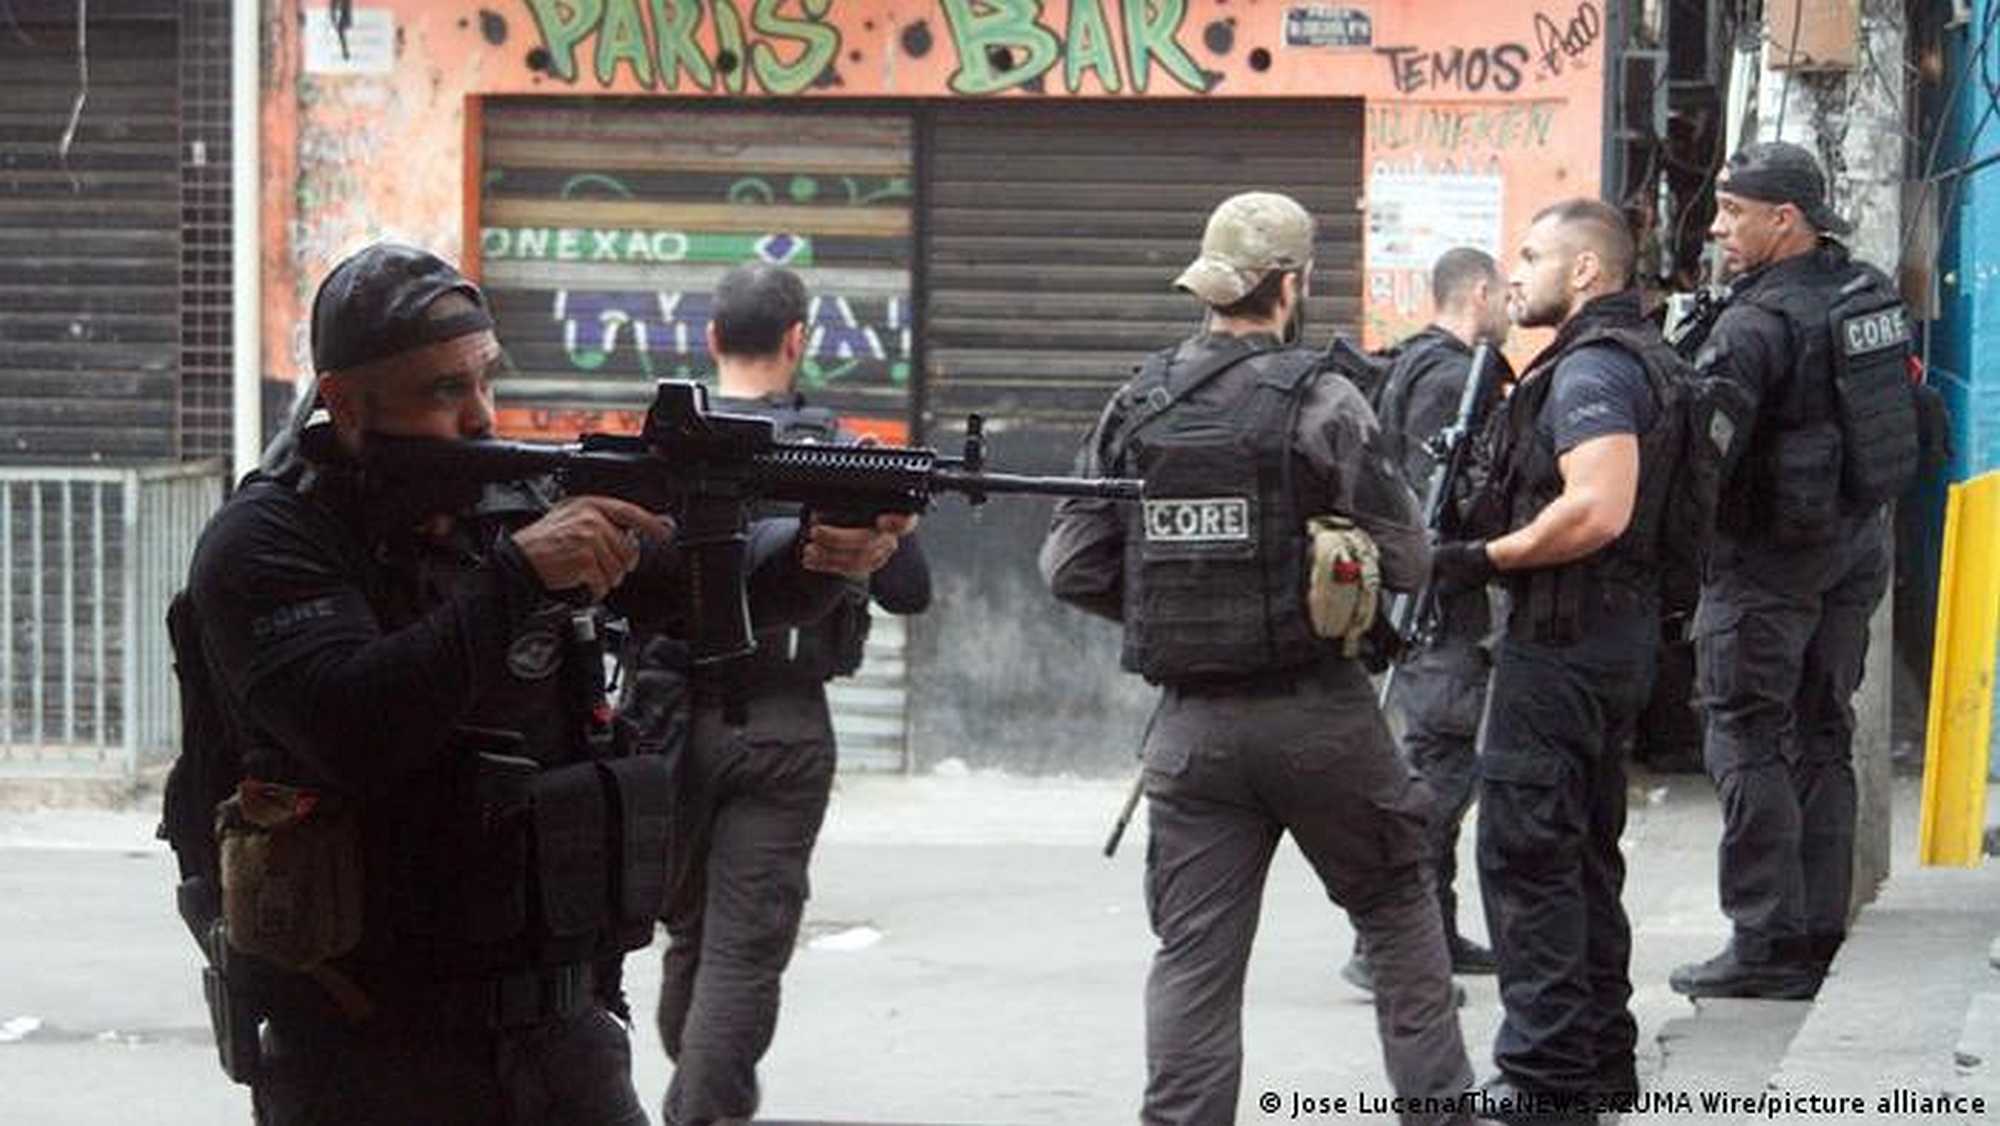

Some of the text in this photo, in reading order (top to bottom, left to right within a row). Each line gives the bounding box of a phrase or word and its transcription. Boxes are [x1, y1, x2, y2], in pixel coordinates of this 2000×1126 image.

[524, 0, 1209, 96] PARIS BAR
[1373, 44, 1529, 92] TEMOS
[1848, 312, 1905, 349] CORE
[1152, 504, 1240, 535] CORE
